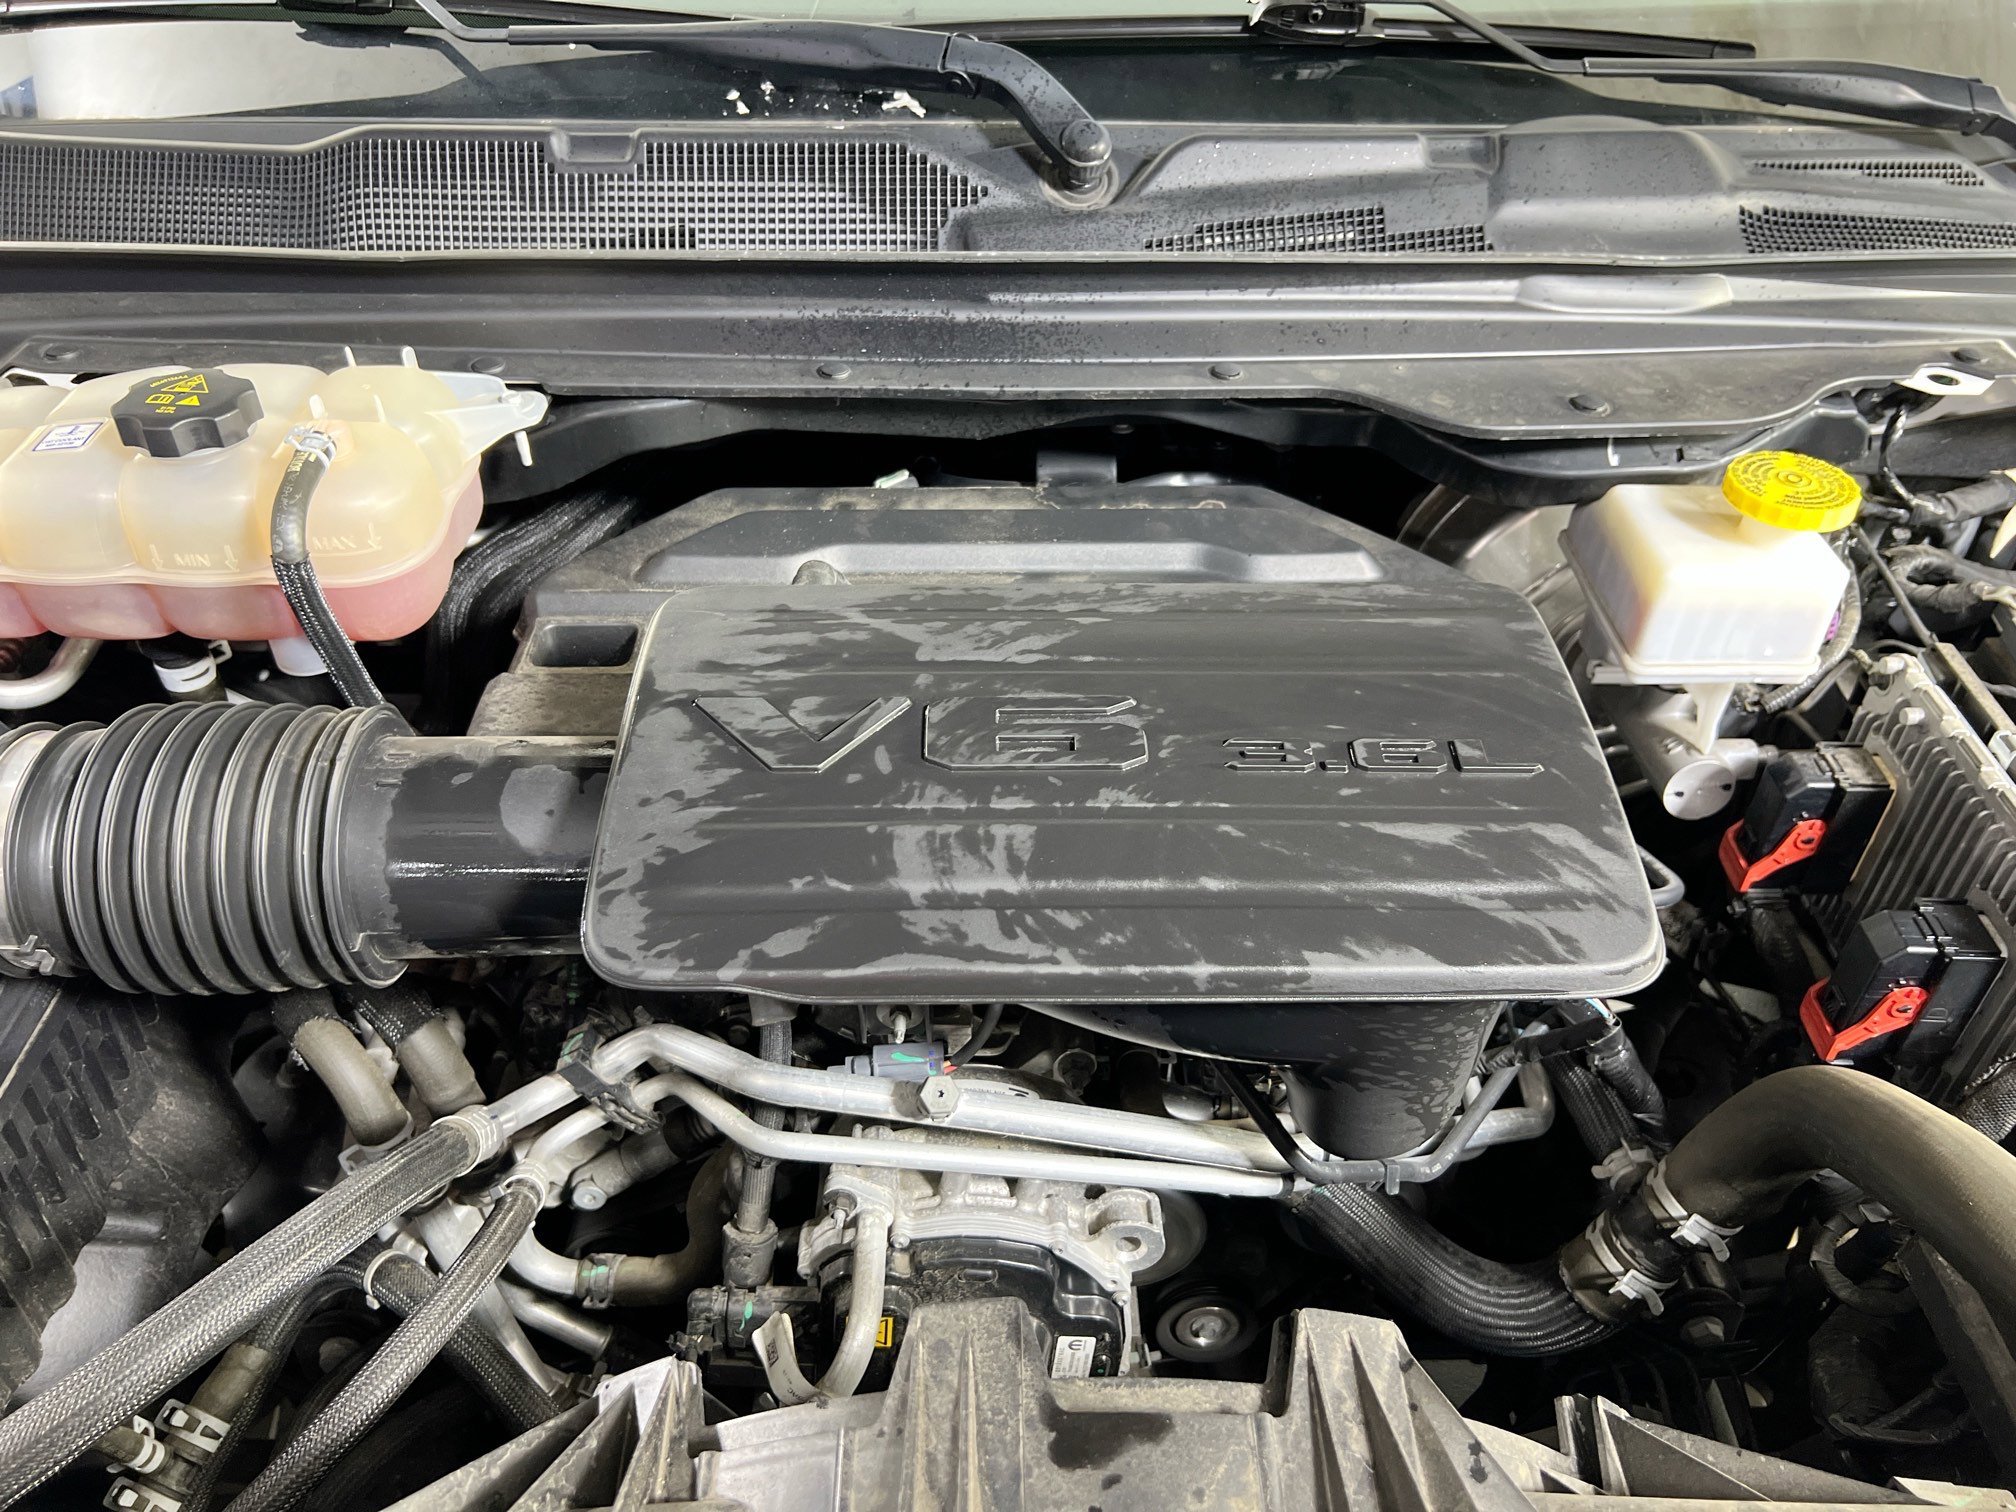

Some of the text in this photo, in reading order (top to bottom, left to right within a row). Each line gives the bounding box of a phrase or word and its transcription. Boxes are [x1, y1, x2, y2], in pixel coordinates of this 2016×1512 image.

[312, 535, 357, 550] MAX
[174, 552, 211, 568] MIN
[692, 695, 1545, 774] V6 3.6L
